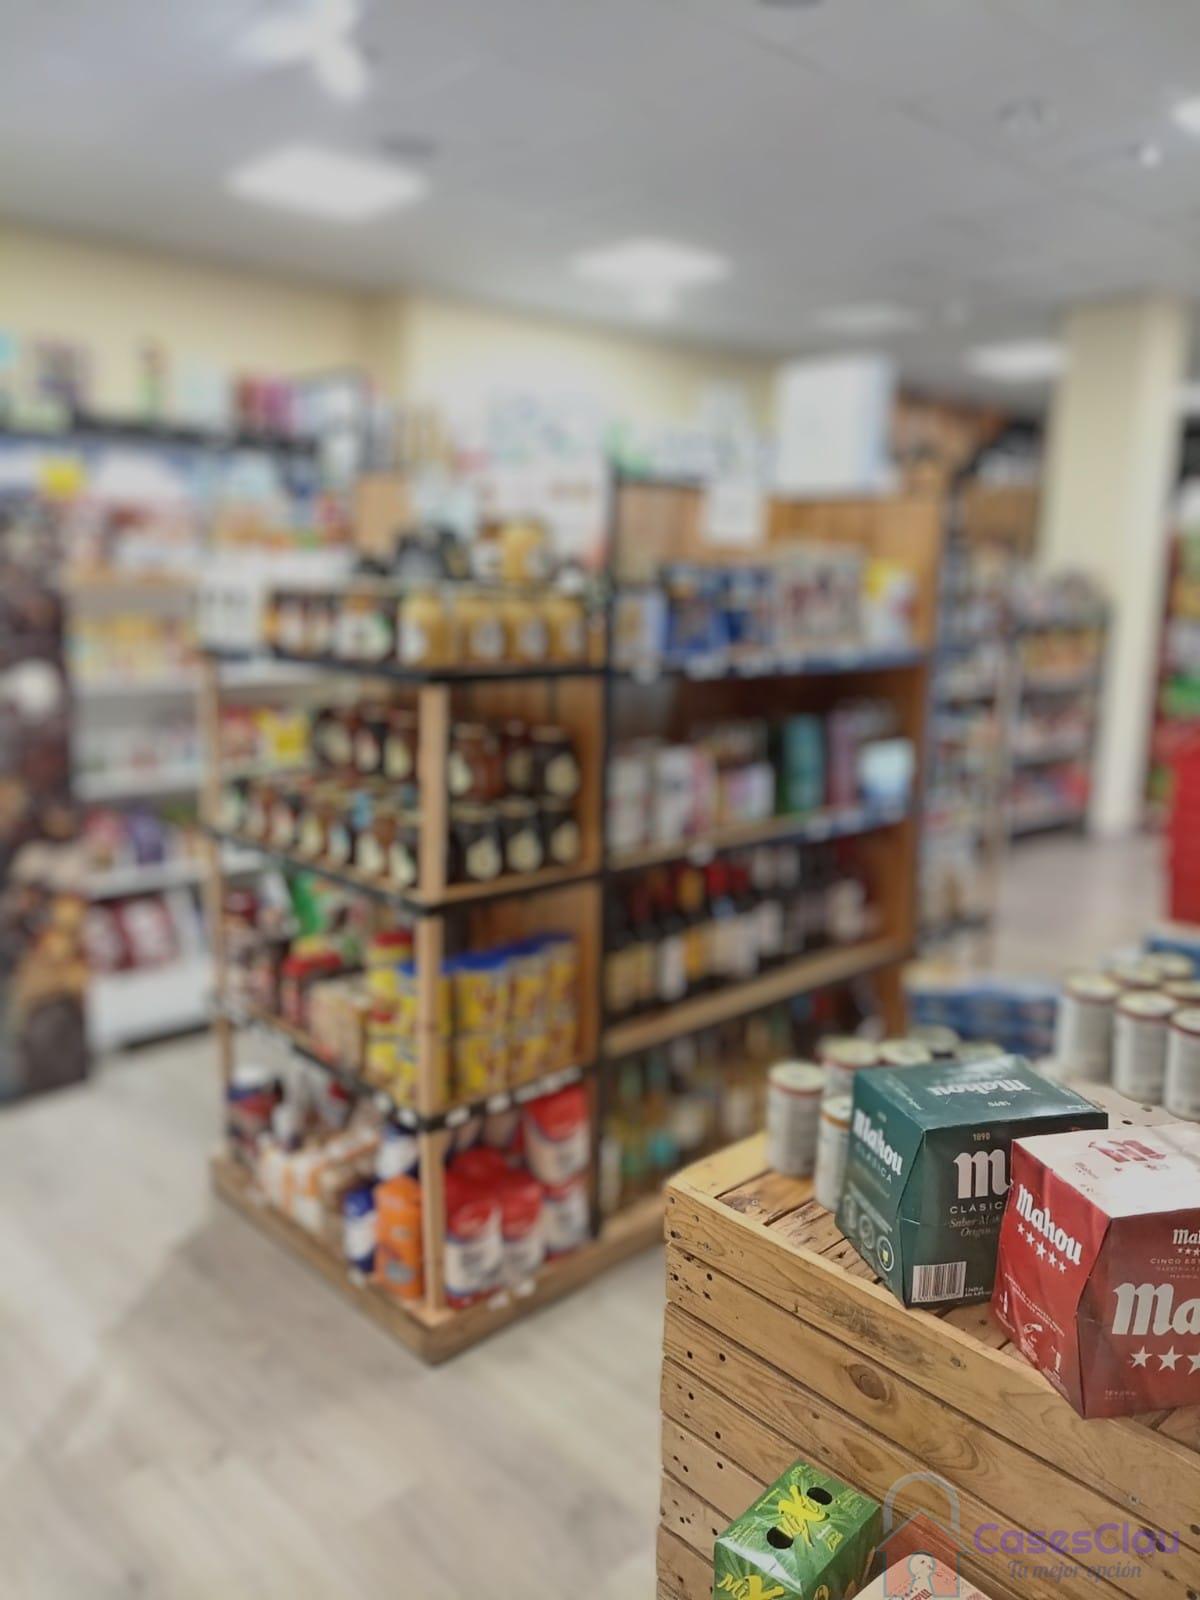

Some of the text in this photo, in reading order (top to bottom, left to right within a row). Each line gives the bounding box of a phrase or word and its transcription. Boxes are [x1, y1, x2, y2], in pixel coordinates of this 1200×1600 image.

[853, 1108, 903, 1176] Mahou
[949, 1201, 1003, 1214] CLASIC
[1016, 1184, 1082, 1265] Mahou
